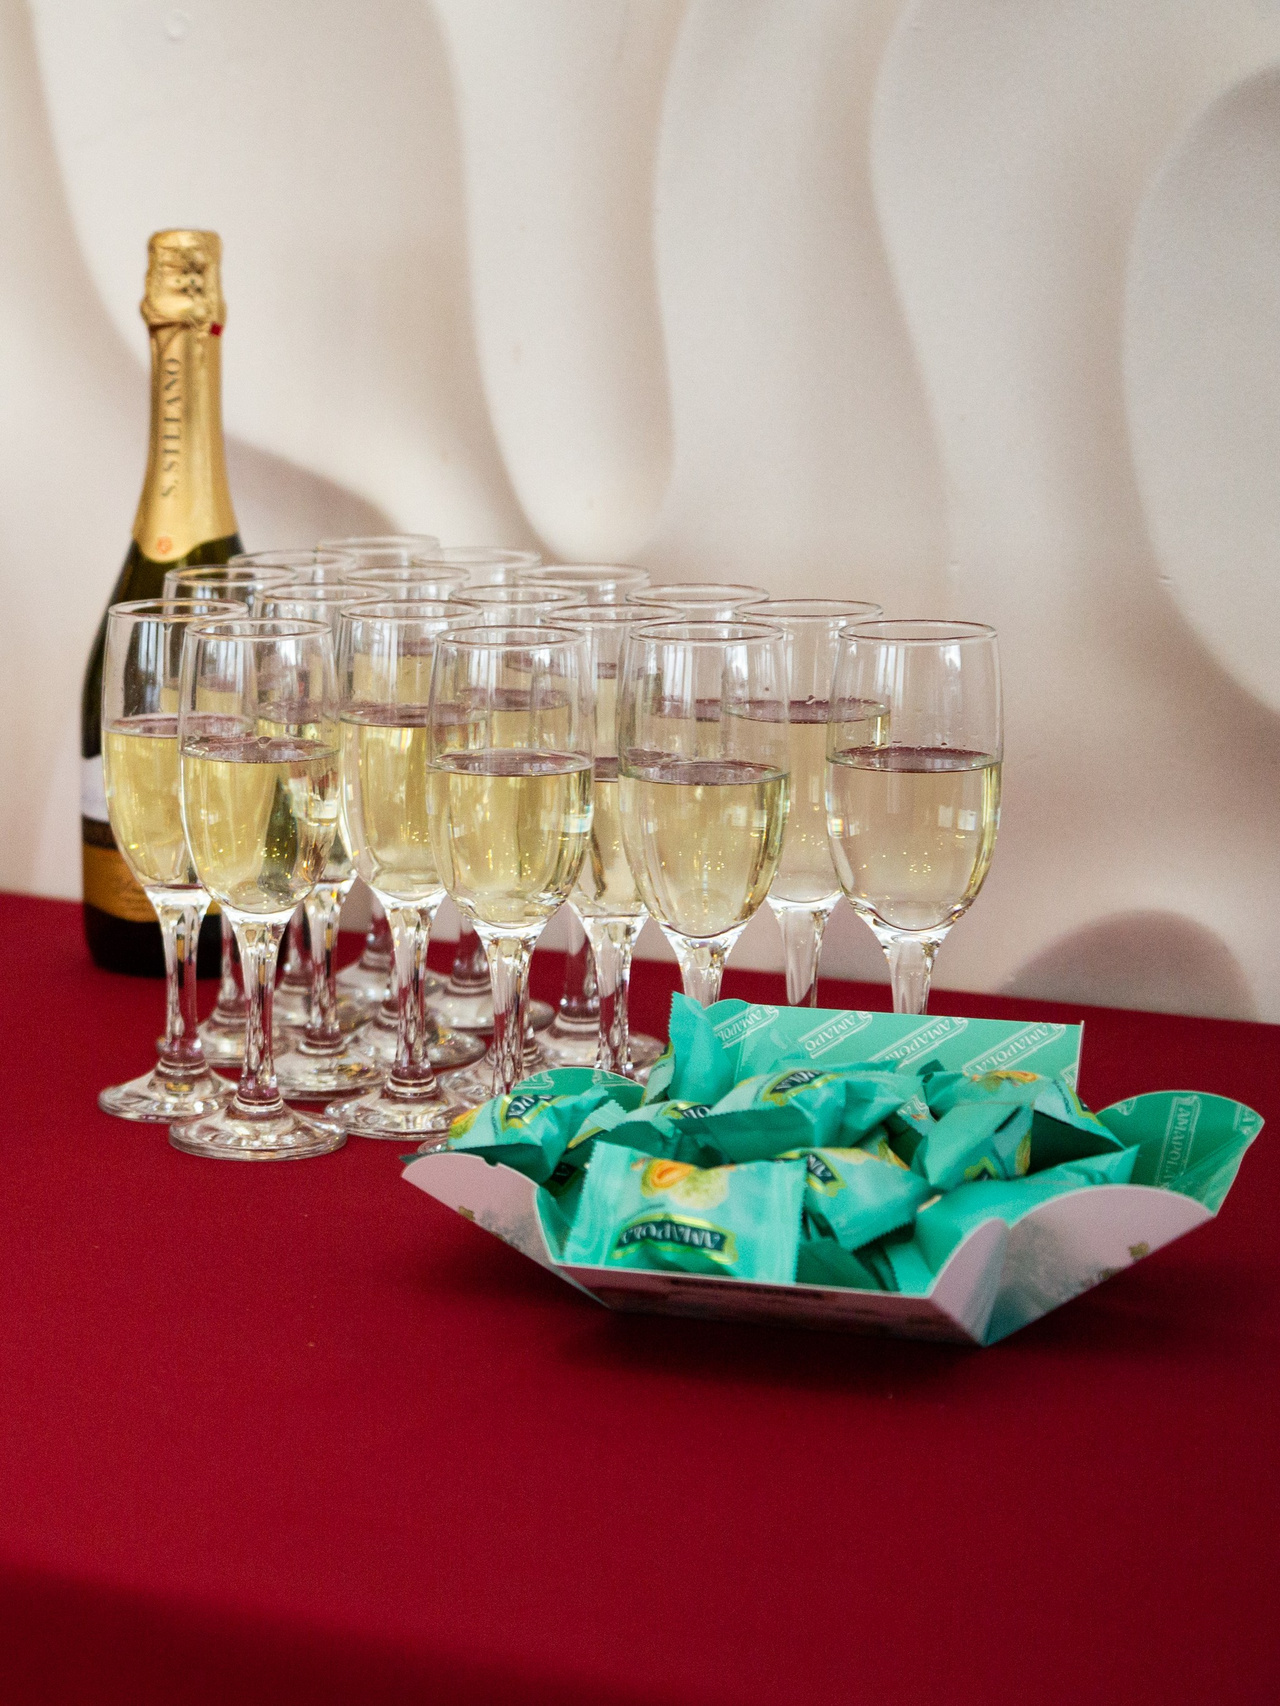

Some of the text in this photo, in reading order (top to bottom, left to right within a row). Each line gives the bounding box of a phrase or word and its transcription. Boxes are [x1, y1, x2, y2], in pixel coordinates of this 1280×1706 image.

[804, 1013, 856, 1051] AMAPO
[974, 1023, 1050, 1073] AMAPOLA
[620, 1222, 720, 1249] AMAPOLA
